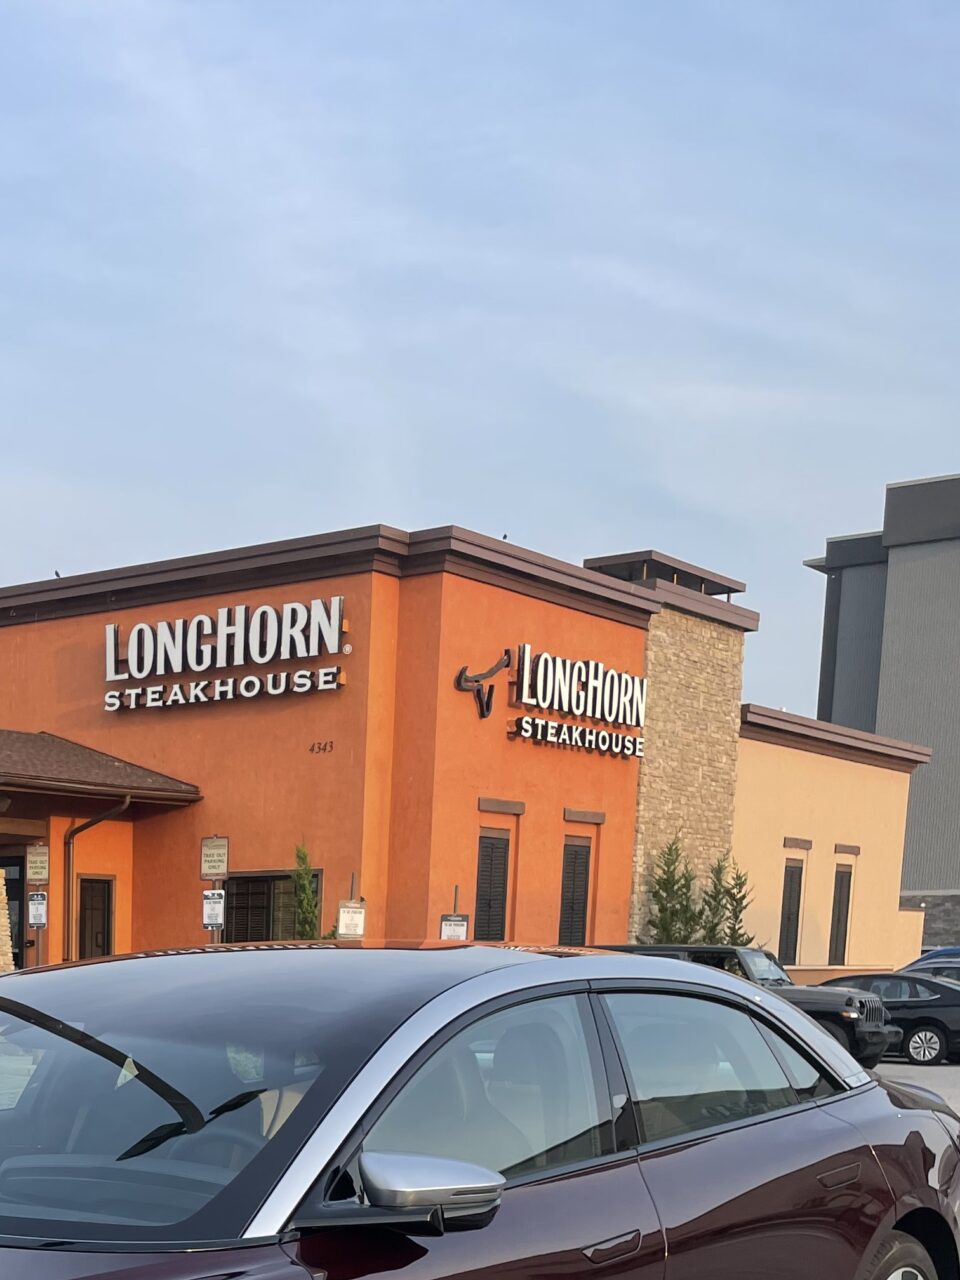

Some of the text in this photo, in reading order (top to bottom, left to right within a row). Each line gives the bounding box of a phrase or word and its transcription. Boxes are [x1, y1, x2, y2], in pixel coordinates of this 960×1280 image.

[105, 596, 345, 682] LONGHORN
[104, 666, 340, 712] STEAKHOUSE
[519, 643, 648, 728] LONGHORN
[309, 740, 334, 754] 4343
[520, 716, 645, 757] STEAKHOUSE
